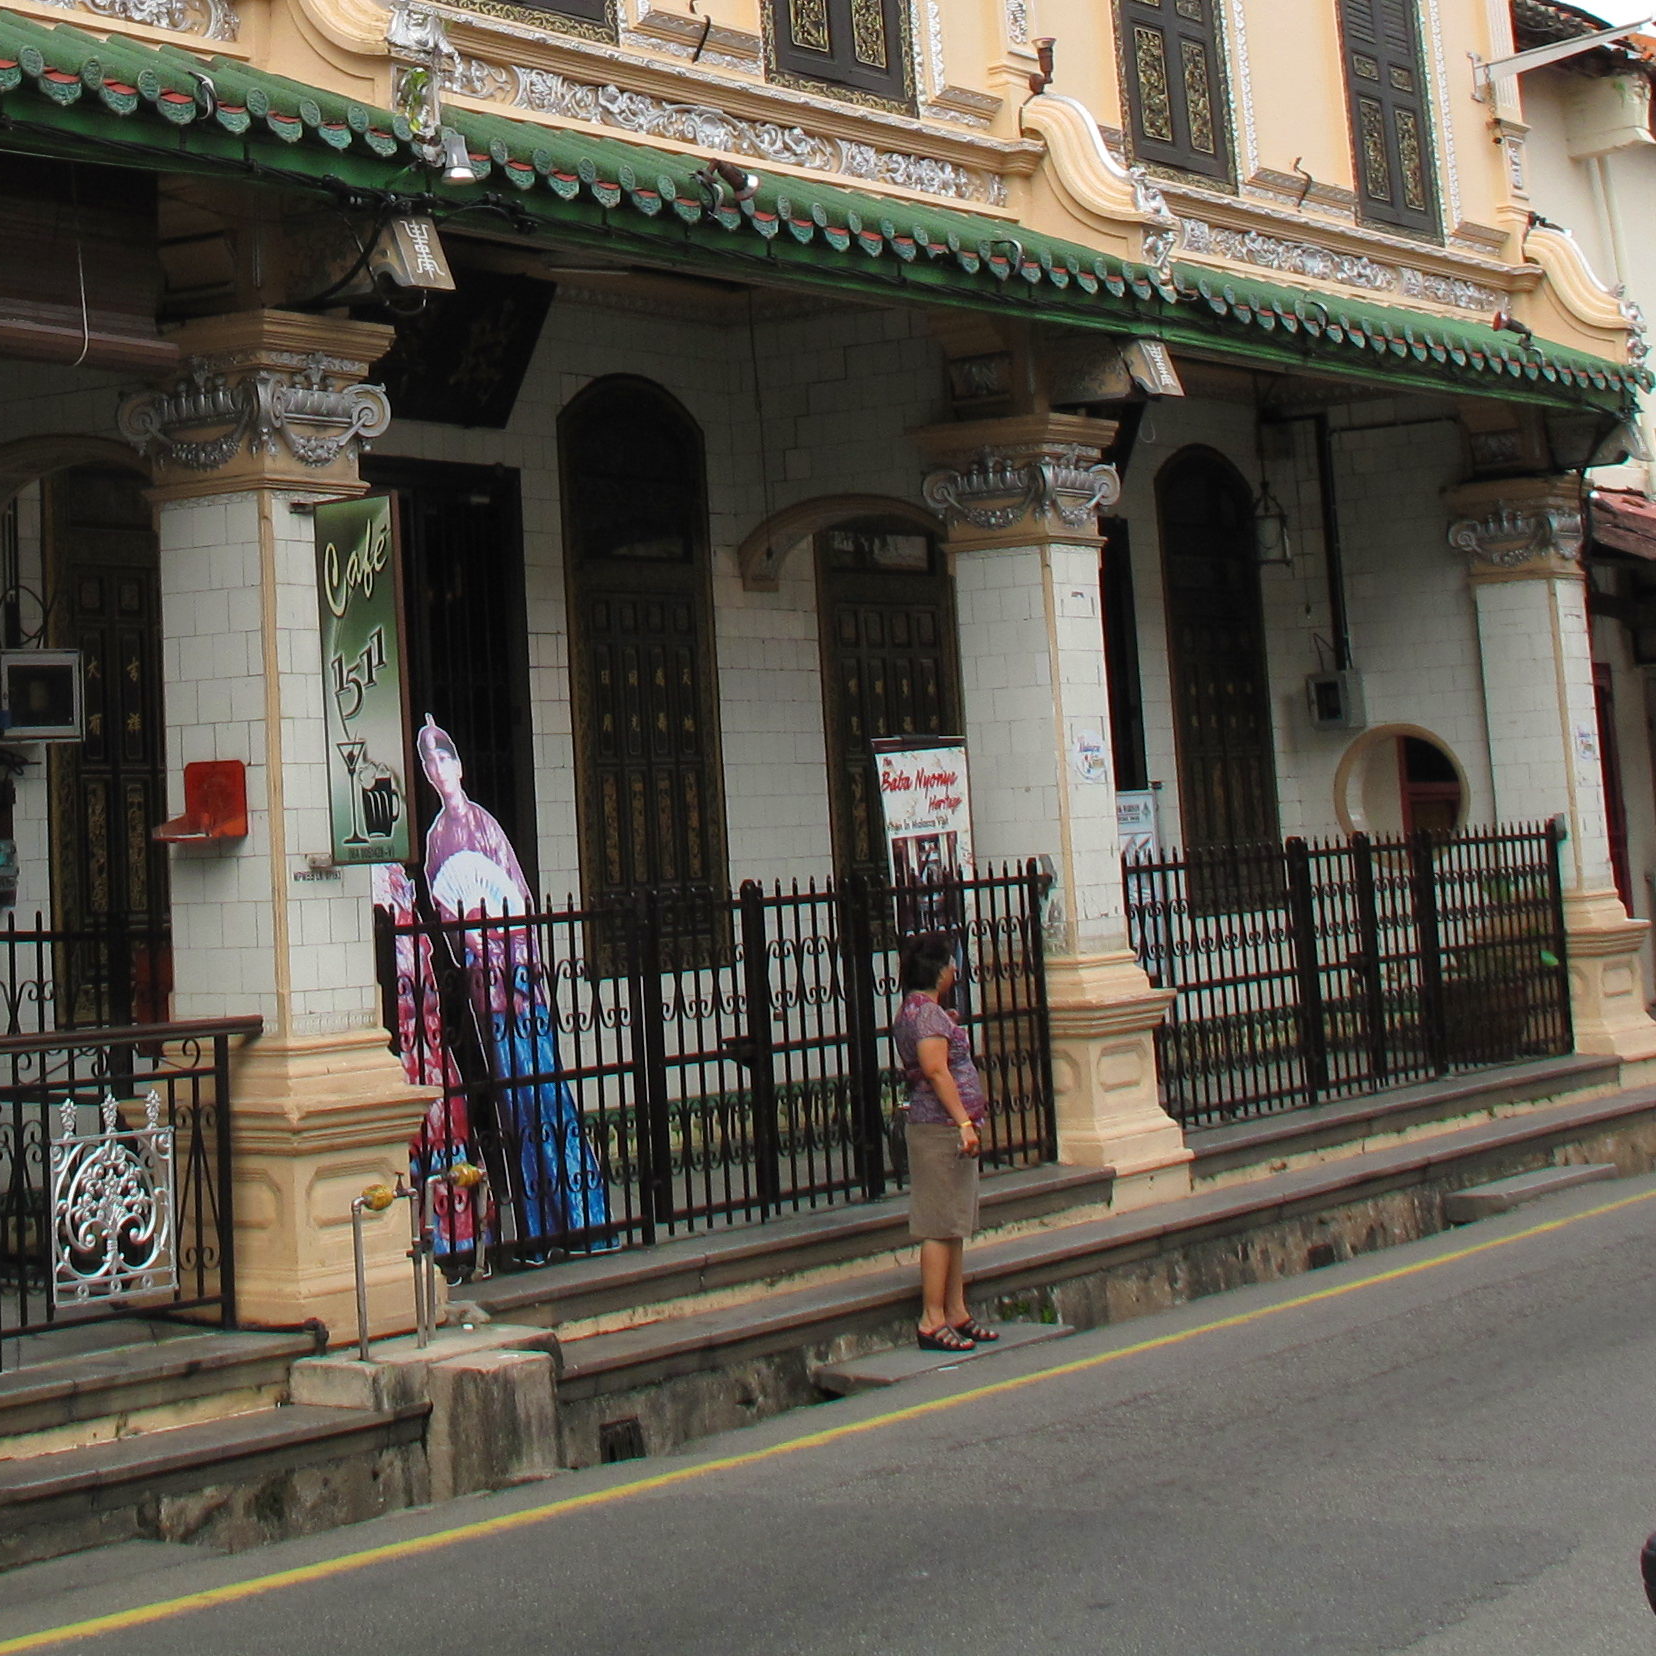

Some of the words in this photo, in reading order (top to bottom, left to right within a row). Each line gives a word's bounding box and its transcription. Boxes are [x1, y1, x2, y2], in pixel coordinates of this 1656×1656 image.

[324, 518, 390, 617] Café
[331, 627, 386, 719] 1511
[881, 769, 913, 792] Baba
